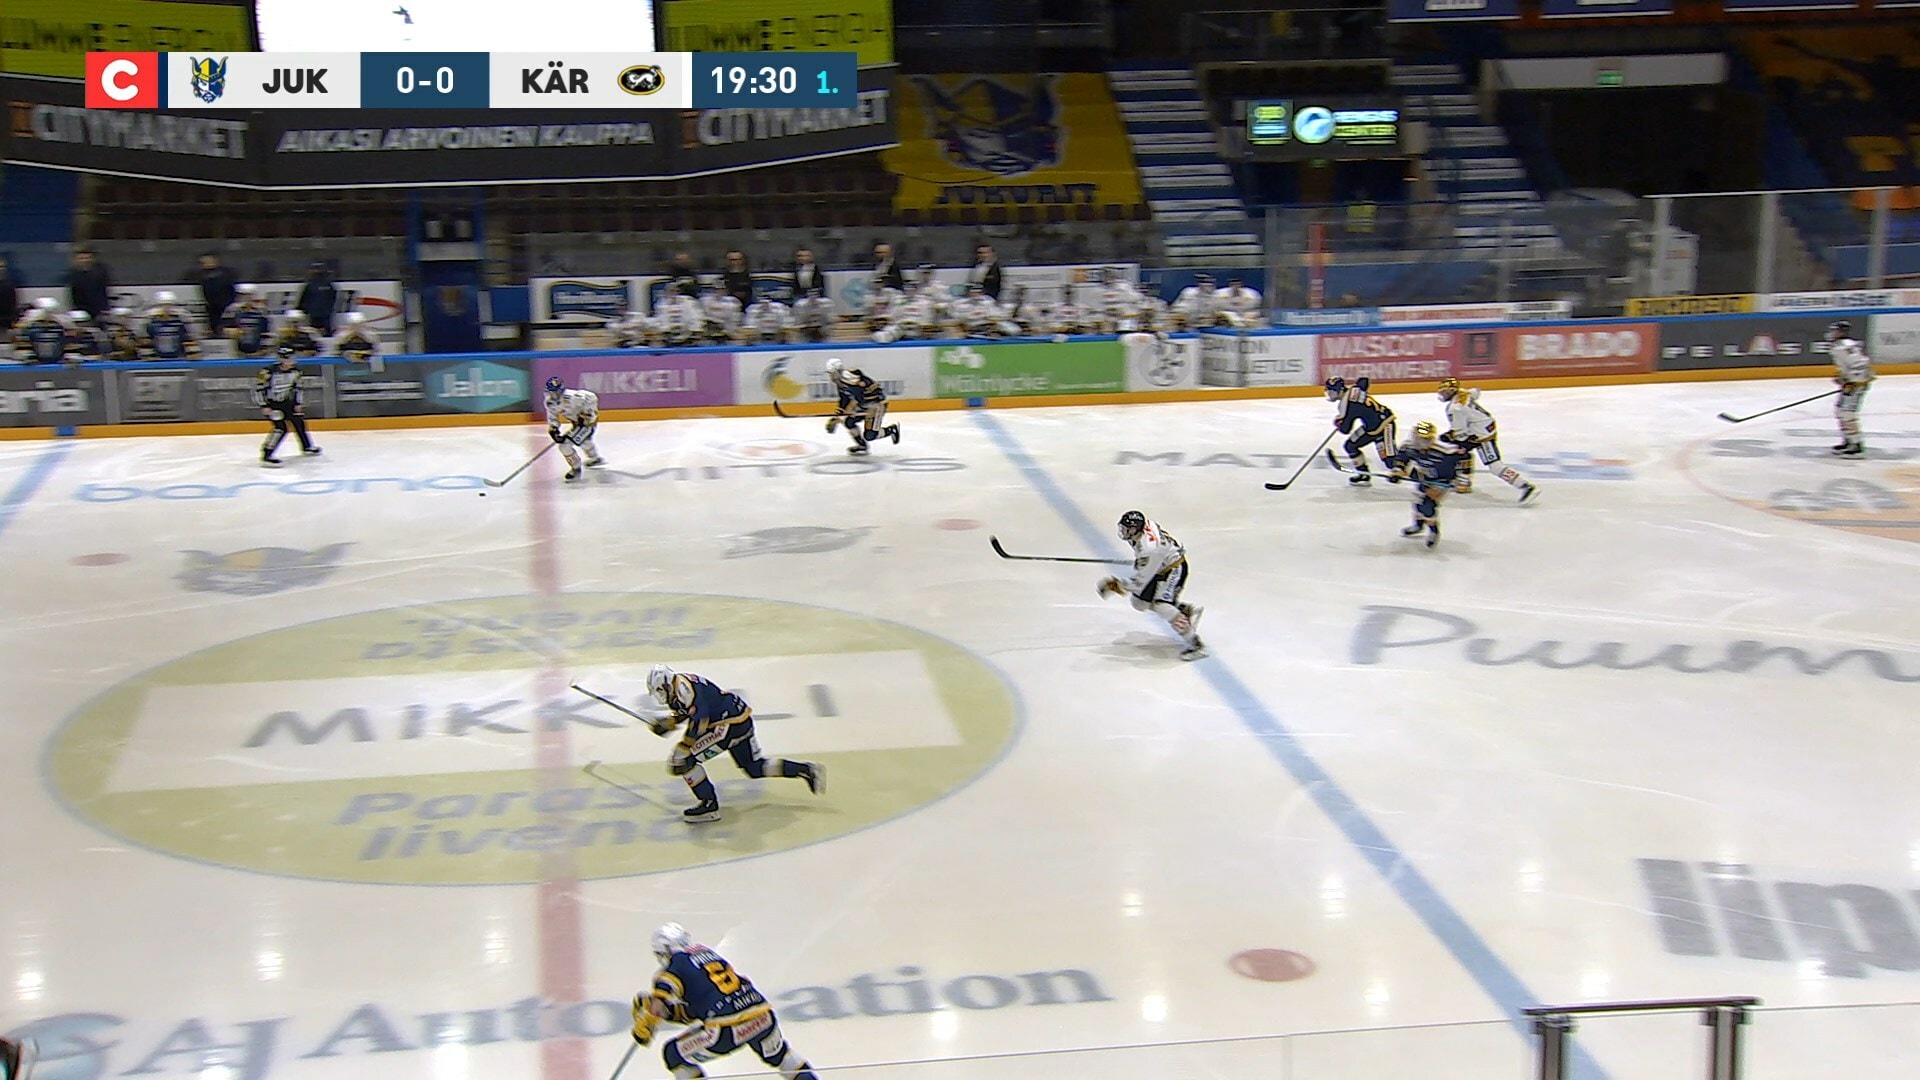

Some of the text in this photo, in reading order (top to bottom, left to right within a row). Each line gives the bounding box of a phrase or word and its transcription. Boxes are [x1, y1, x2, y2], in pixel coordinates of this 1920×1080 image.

[1516, 330, 1642, 361] BRADO
[437, 366, 521, 400] Jalon
[1635, 857, 1920, 979] lip
[297, 965, 1114, 1060] Autoation
